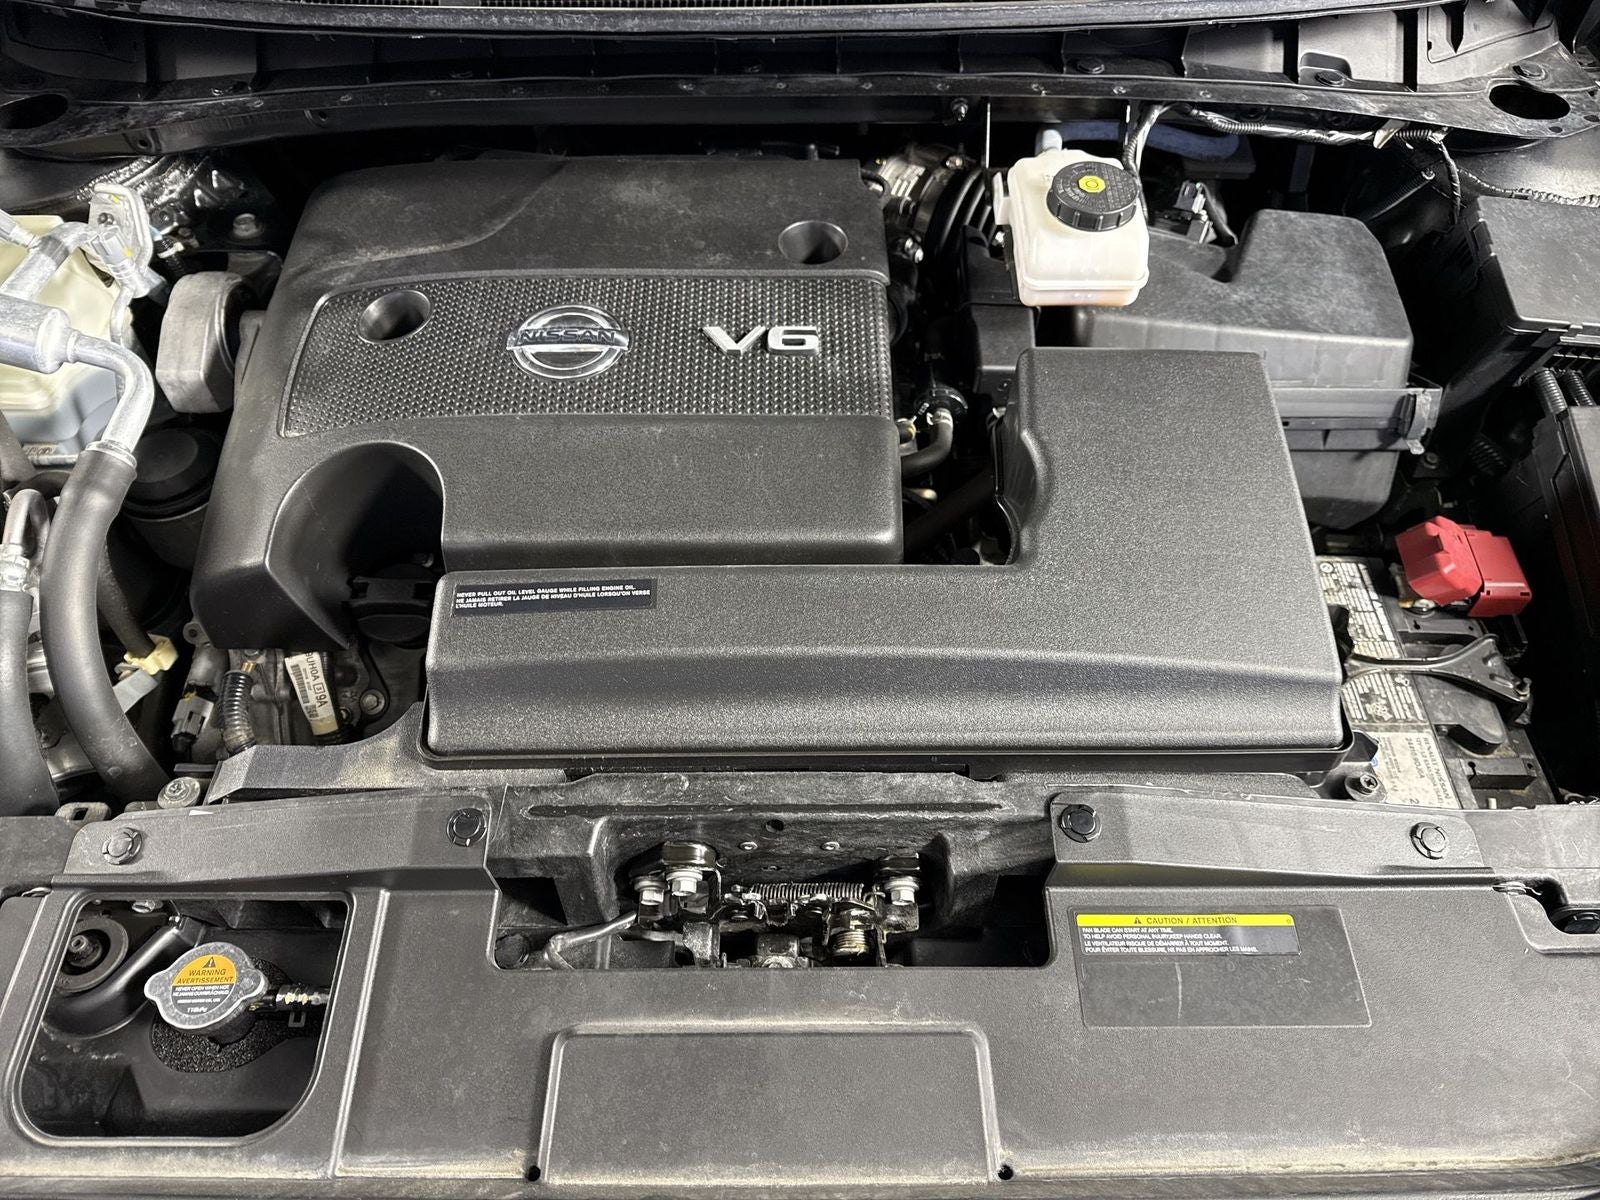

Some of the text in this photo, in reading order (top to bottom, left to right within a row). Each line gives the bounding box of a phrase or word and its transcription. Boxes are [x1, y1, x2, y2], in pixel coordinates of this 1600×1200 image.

[520, 329, 616, 342] NISSAN
[703, 324, 822, 356] V6
[315, 694, 328, 707] 9A
